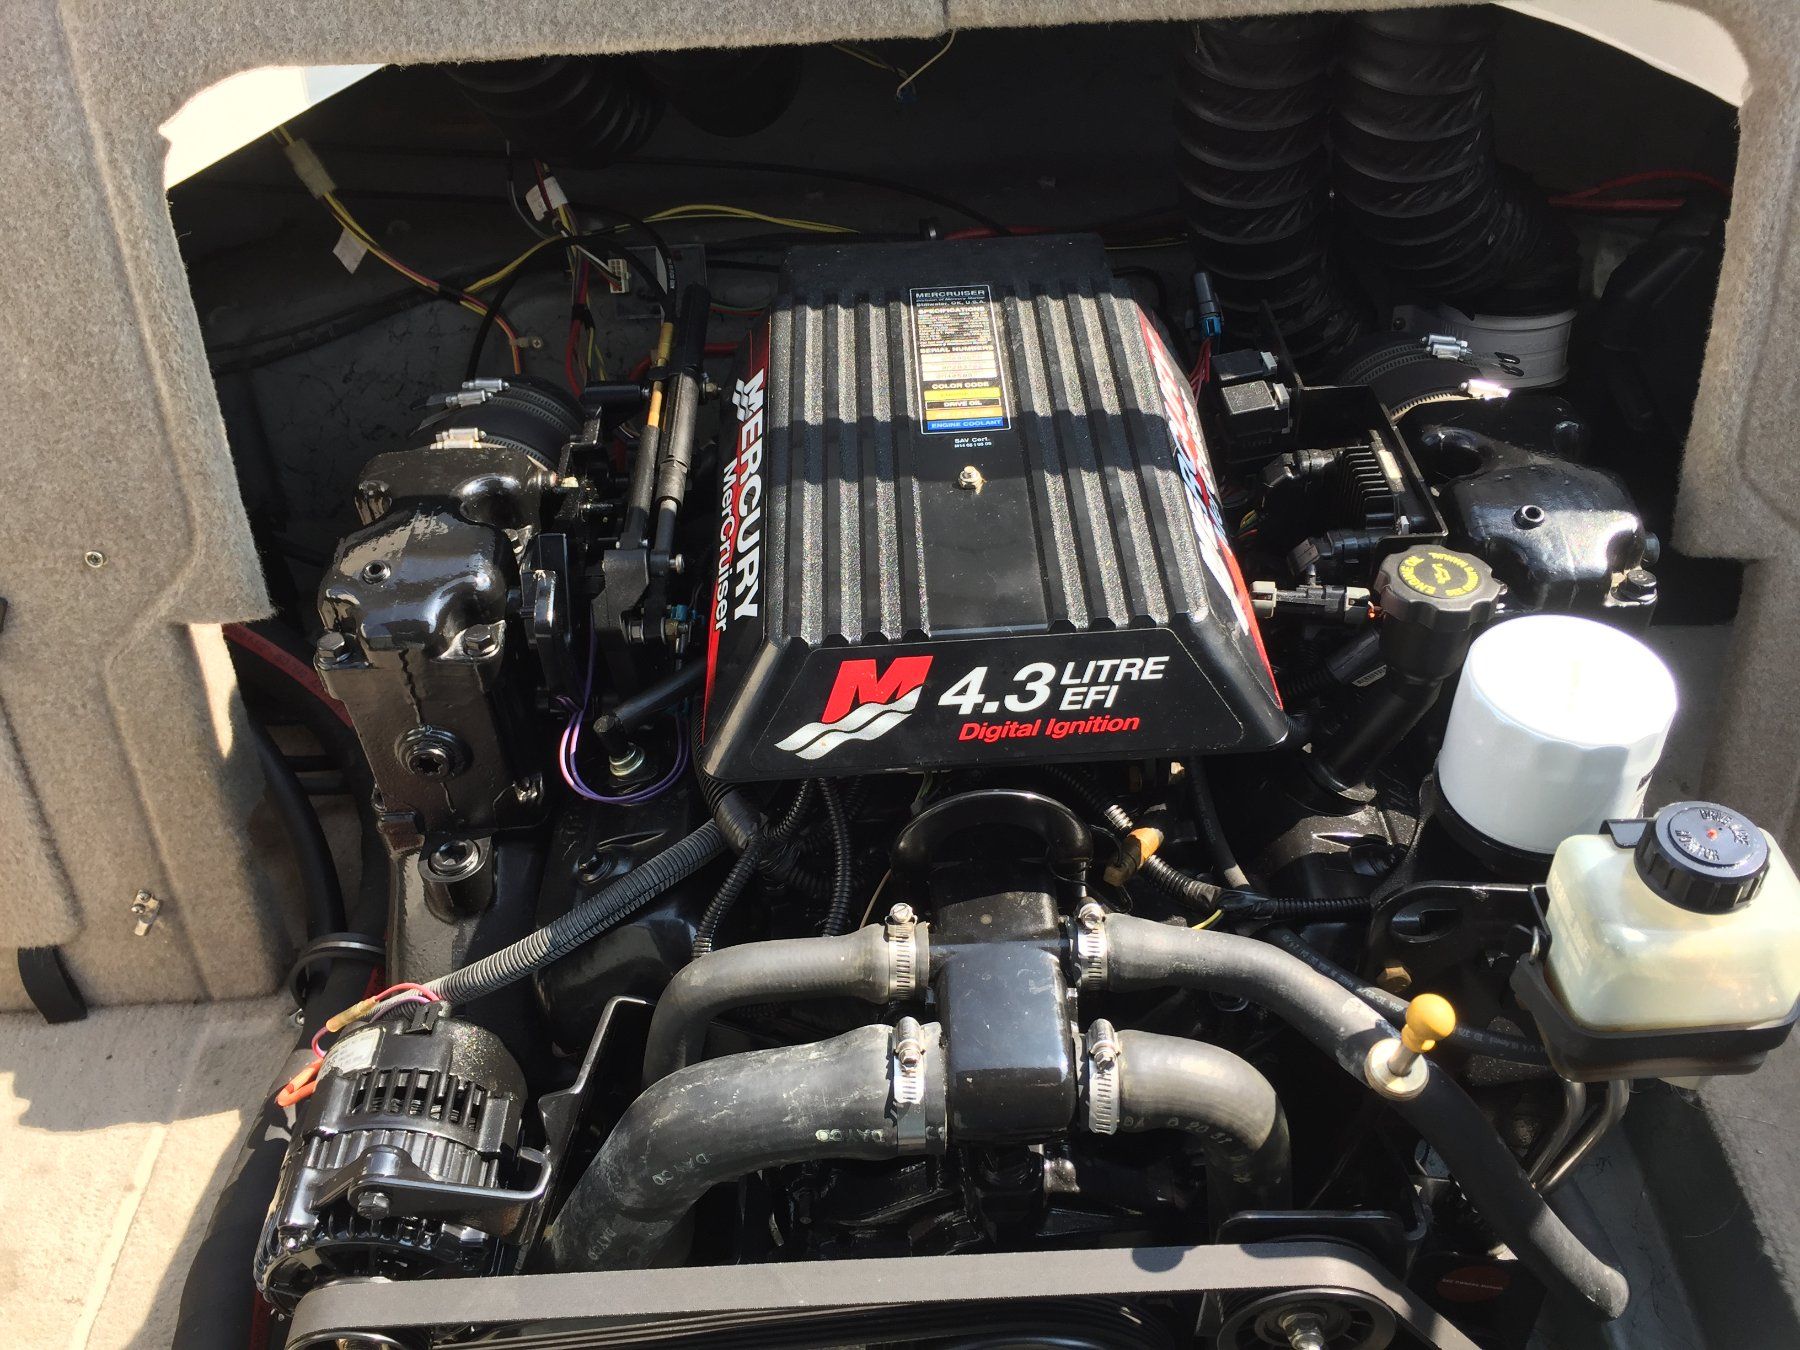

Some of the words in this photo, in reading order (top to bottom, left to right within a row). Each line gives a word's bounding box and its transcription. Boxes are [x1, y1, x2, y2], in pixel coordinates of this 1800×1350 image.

[915, 290, 985, 299] MERCRUISER
[918, 306, 985, 314] SPECIFICATIONS
[963, 419, 1001, 427] COOLANT
[734, 368, 764, 620] MERCURY
[715, 457, 738, 632] MerCruiser
[1059, 655, 1170, 686] LITRE
[937, 662, 1057, 715] 4.3
[1058, 685, 1119, 711] EFI
[958, 718, 1042, 743] Digital
[1045, 715, 1141, 739] Ignition
